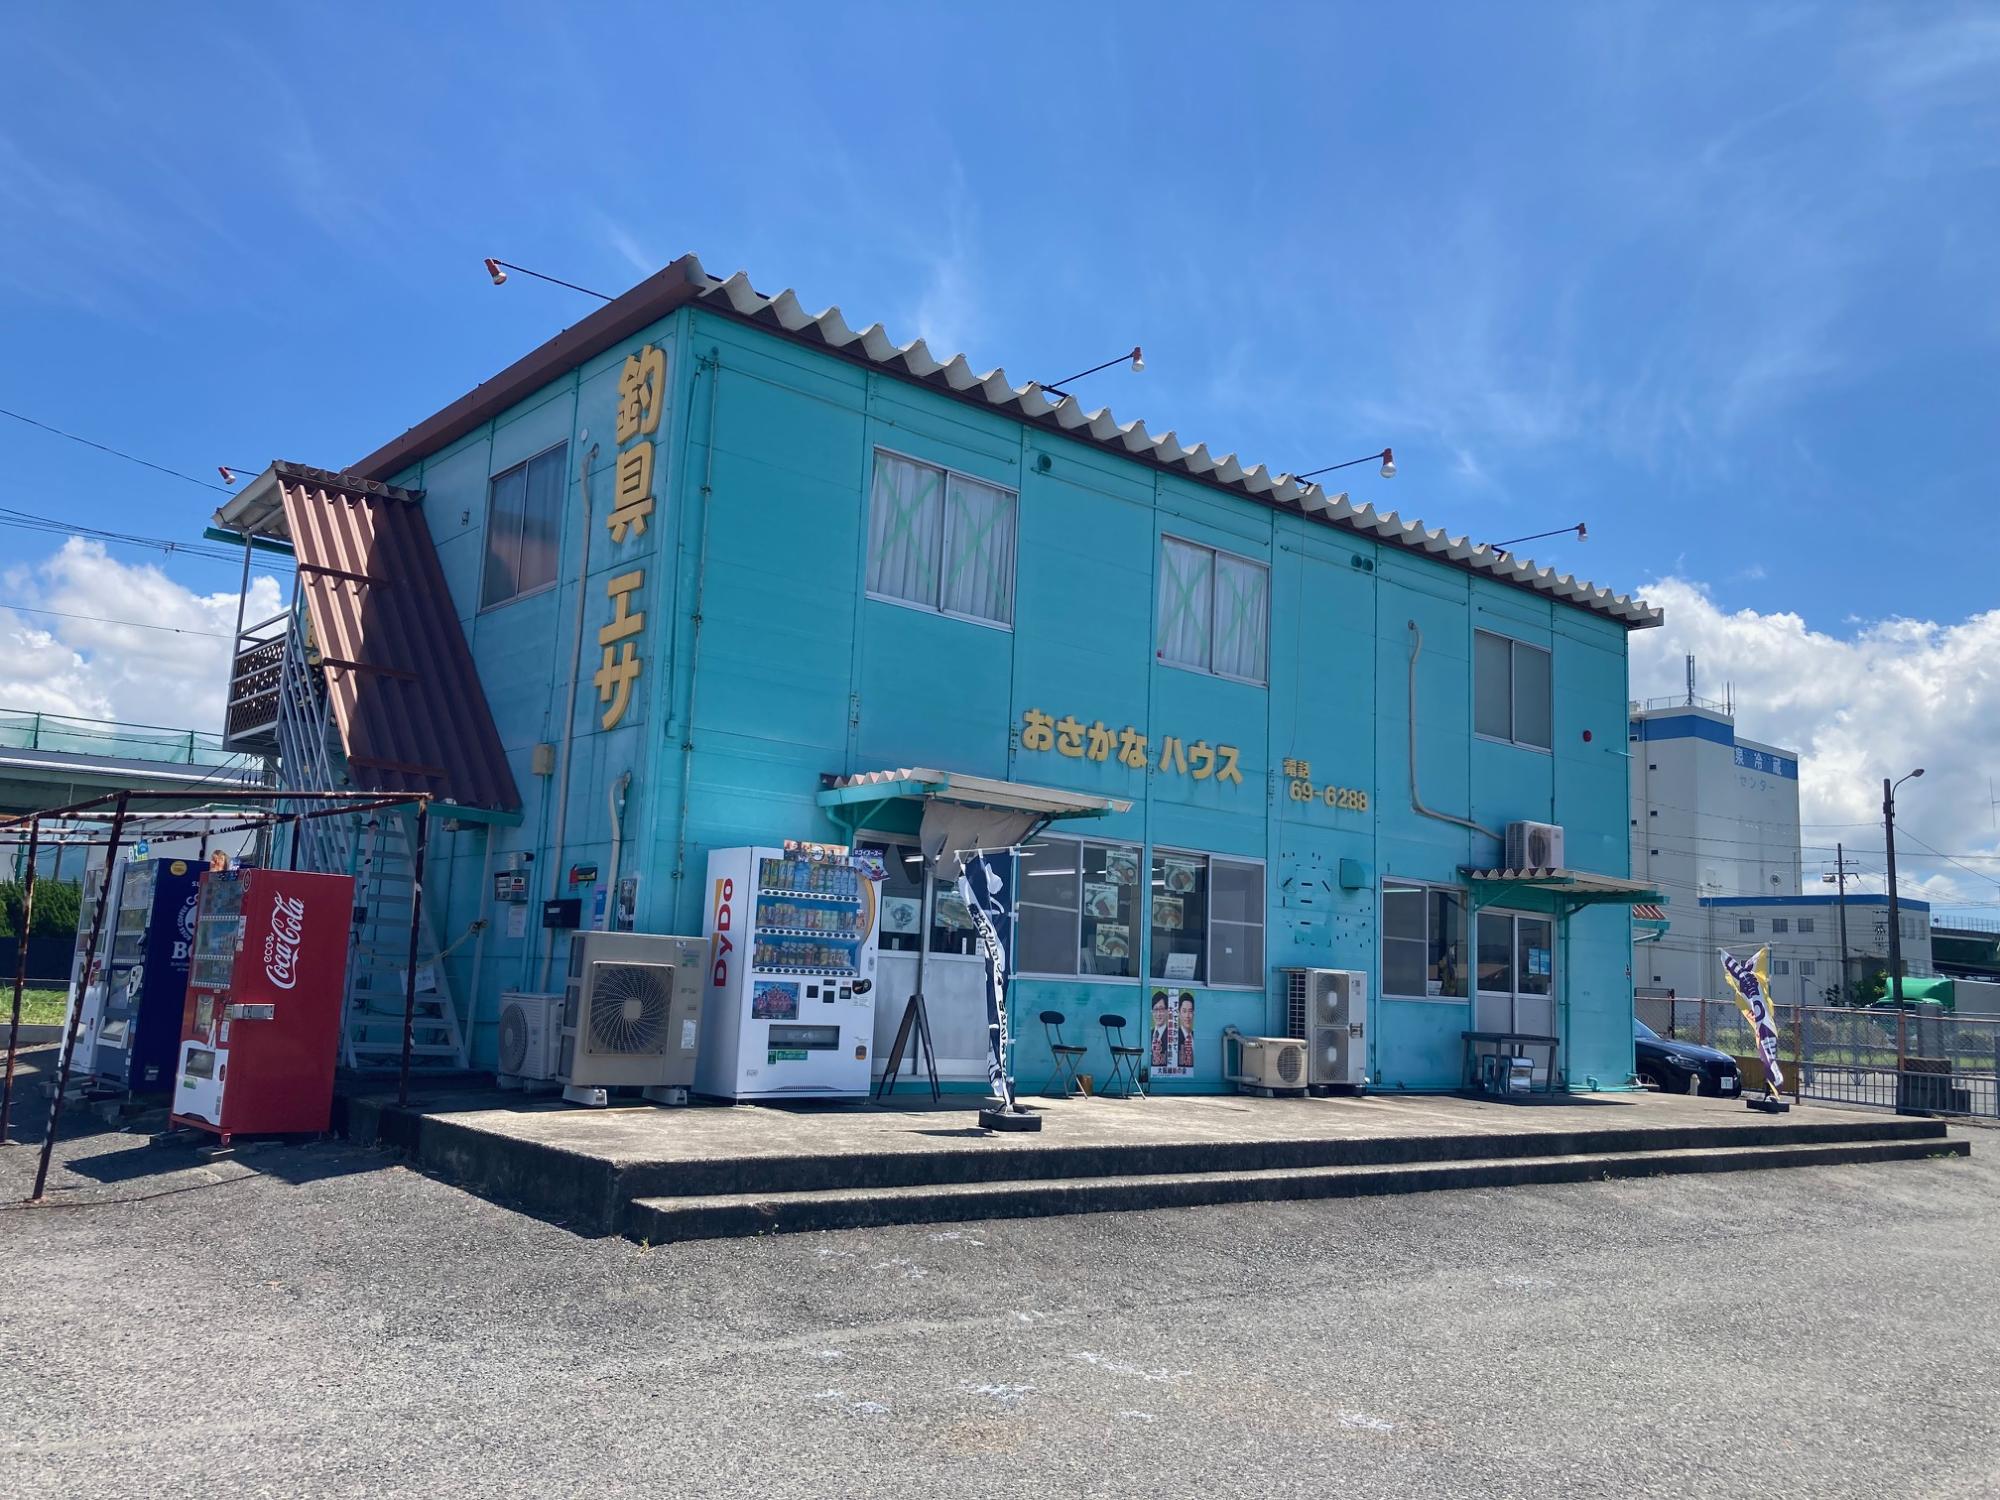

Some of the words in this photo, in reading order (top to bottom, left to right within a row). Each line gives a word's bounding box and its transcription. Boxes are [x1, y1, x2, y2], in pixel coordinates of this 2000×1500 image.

[607, 344, 667, 543] 釣具
[594, 568, 645, 730] エサ
[1022, 708, 1148, 769] おさかな
[1158, 735, 1243, 785] ハウス
[1284, 758, 1310, 779] 電話
[1290, 780, 1368, 812] 69-6288
[266, 891, 305, 989] Coca-Cola
